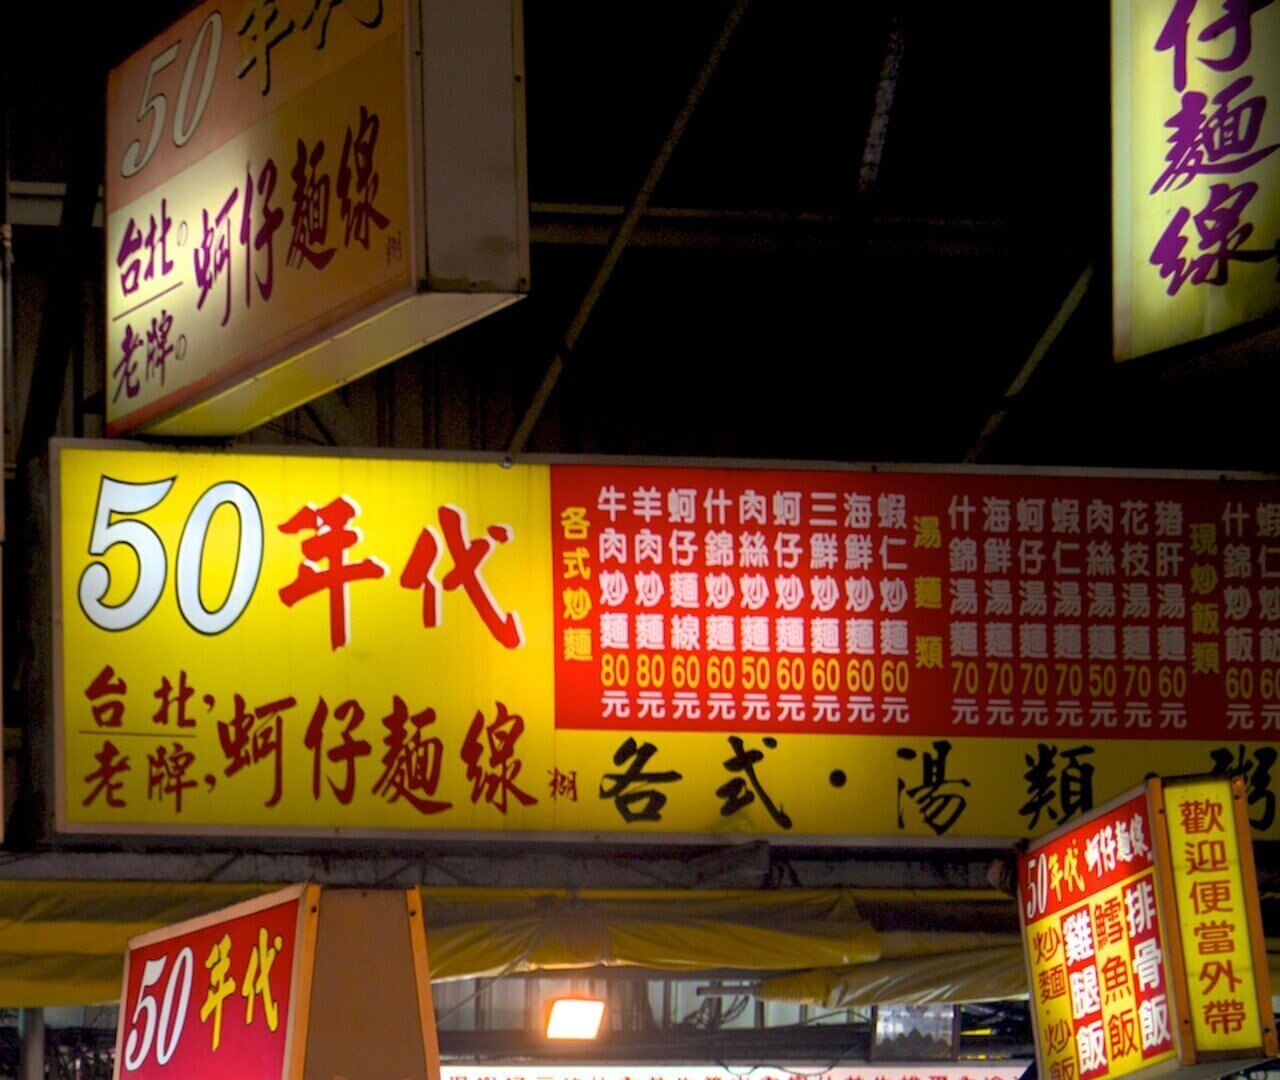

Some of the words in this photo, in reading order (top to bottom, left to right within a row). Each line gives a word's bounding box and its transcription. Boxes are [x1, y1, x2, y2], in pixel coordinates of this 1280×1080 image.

[78, 474, 526, 652] 50年代
[560, 506, 593, 662] 各式炒麵
[217, 694, 538, 815] 蚵仔麵線
[125, 926, 284, 1071] 50年代
[1061, 910, 1108, 1076] 雞腿飯
[1093, 896, 1139, 1062] 鱈魚飯
[1124, 879, 1172, 1052] 排骨飯
[1179, 798, 1247, 1035] 歡迎便當外帶
